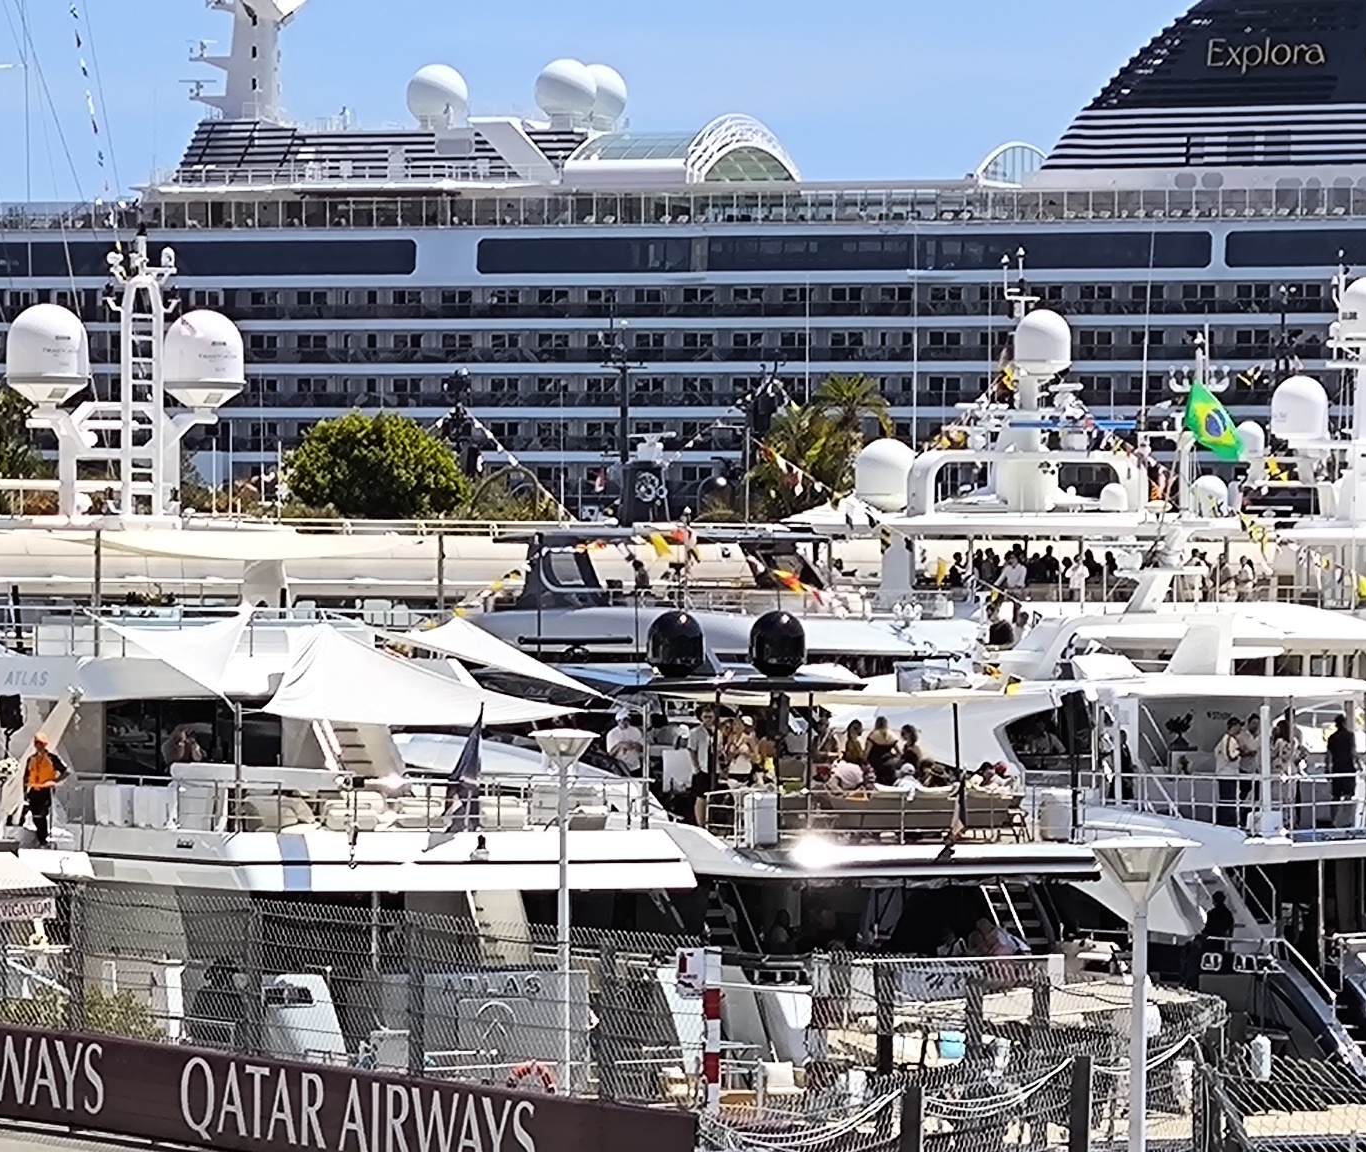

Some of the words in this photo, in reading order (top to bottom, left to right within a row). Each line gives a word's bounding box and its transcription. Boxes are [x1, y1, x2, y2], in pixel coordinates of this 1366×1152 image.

[1207, 36, 1326, 74] Explora
[4, 670, 49, 687] ATLAS
[442, 974, 543, 996] ATLAS
[180, 1055, 328, 1149] QATAR
